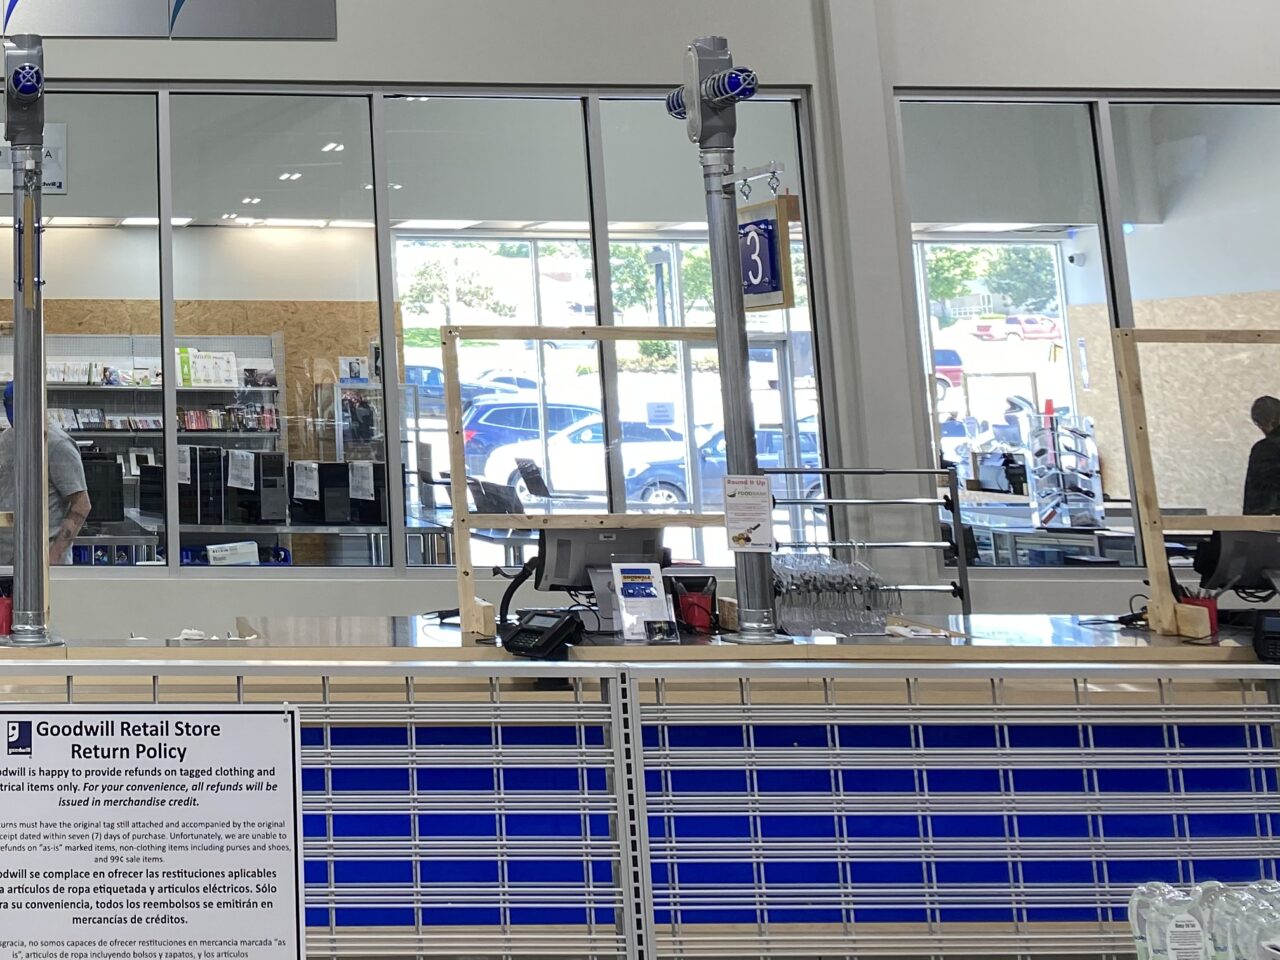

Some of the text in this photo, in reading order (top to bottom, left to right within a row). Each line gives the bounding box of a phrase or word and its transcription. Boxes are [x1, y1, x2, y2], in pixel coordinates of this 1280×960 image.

[746, 230, 763, 285] 3
[36, 720, 220, 737] Goodwill Retail Store
[71, 742, 187, 763] Return Policy
[28, 767, 36, 777] is
[38, 767, 70, 779] happy
[71, 768, 82, 777] to
[84, 766, 122, 779] provide
[124, 766, 162, 777] refunds
[164, 769, 177, 777] on
[179, 766, 213, 779] tagged
[214, 766, 255, 779] clothing
[256, 766, 276, 777] and
[26, 782, 55, 792] items
[56, 782, 81, 794] only.
[82, 782, 100, 792] For
[100, 784, 125, 794] your
[125, 782, 189, 793] convenience,
[191, 781, 205, 792] all
[206, 781, 244, 794] refunds
[245, 781, 264, 792] will
[265, 781, 278, 792] be
[58, 796, 200, 807] issued in merchandise credit.
[39, 820, 58, 829] have
[59, 820, 72, 829] the
[73, 820, 102, 831] original
[102, 821, 115, 831] tag
[116, 820, 130, 829] still
[131, 820, 164, 829] attached
[165, 820, 180, 828] and
[181, 820, 231, 830] accompanied
[232, 820, 242, 830] by
[242, 820, 256, 828] the
[257, 820, 286, 830] original
[19, 832, 42, 840] dated
[42, 832, 67, 840] within
[91, 832, 102, 842] (7)
[103, 832, 121, 842] days
[122, 832, 131, 840] of
[132, 832, 168, 842] purchase.
[169, 832, 223, 842] Unfortunately,
[251, 832, 277, 840] unable
[64, 843, 93, 852] marked
[94, 844, 118, 853] items,
[119, 843, 167, 854] non-clothing
[168, 844, 189, 852] items
[190, 843, 225, 853] including
[252, 843, 267, 852] and
[268, 843, 292, 852] shoes,
[94, 855, 108, 864] and
[125, 855, 141, 864] sale
[142, 855, 165, 864] items.
[29, 871, 40, 879] se
[42, 868, 90, 881] complace
[92, 871, 105, 879] en
[107, 868, 144, 879] ofrecer
[146, 868, 160, 879] las
[162, 868, 226, 879] restituciones
[228, 868, 277, 881] aplicables
[52, 884, 65, 894] de
[67, 886, 91, 896] ropa
[92, 883, 147, 896] etiquetada
[148, 886, 156, 896] y
[202, 883, 253, 894] eléctricos.
[255, 883, 277, 894] Sólo
[11, 901, 23, 910] su
[25, 899, 93, 911] conveniencia,
[95, 899, 124, 909] todos
[126, 898, 141, 910] los
[142, 898, 201, 909] reembolsos
[202, 901, 214, 909] se
[216, 898, 258, 909] emitirán
[72, 914, 188, 925] mercancías de créditos.
[66, 940, 97, 948] capaces
[97, 938, 108, 947] de
[109, 938, 137, 947] ofrecer
[138, 938, 187, 947] restituciones
[240, 938, 273, 947] marcada
[58, 950, 69, 959] de
[70, 952, 89, 960] ropa
[89, 950, 132, 960] incluyendo
[132, 950, 157, 959] bolsos
[158, 952, 164, 960] y
[164, 951, 196, 960] zapatos,
[197, 952, 202, 960] y
[203, 950, 215, 959] los
